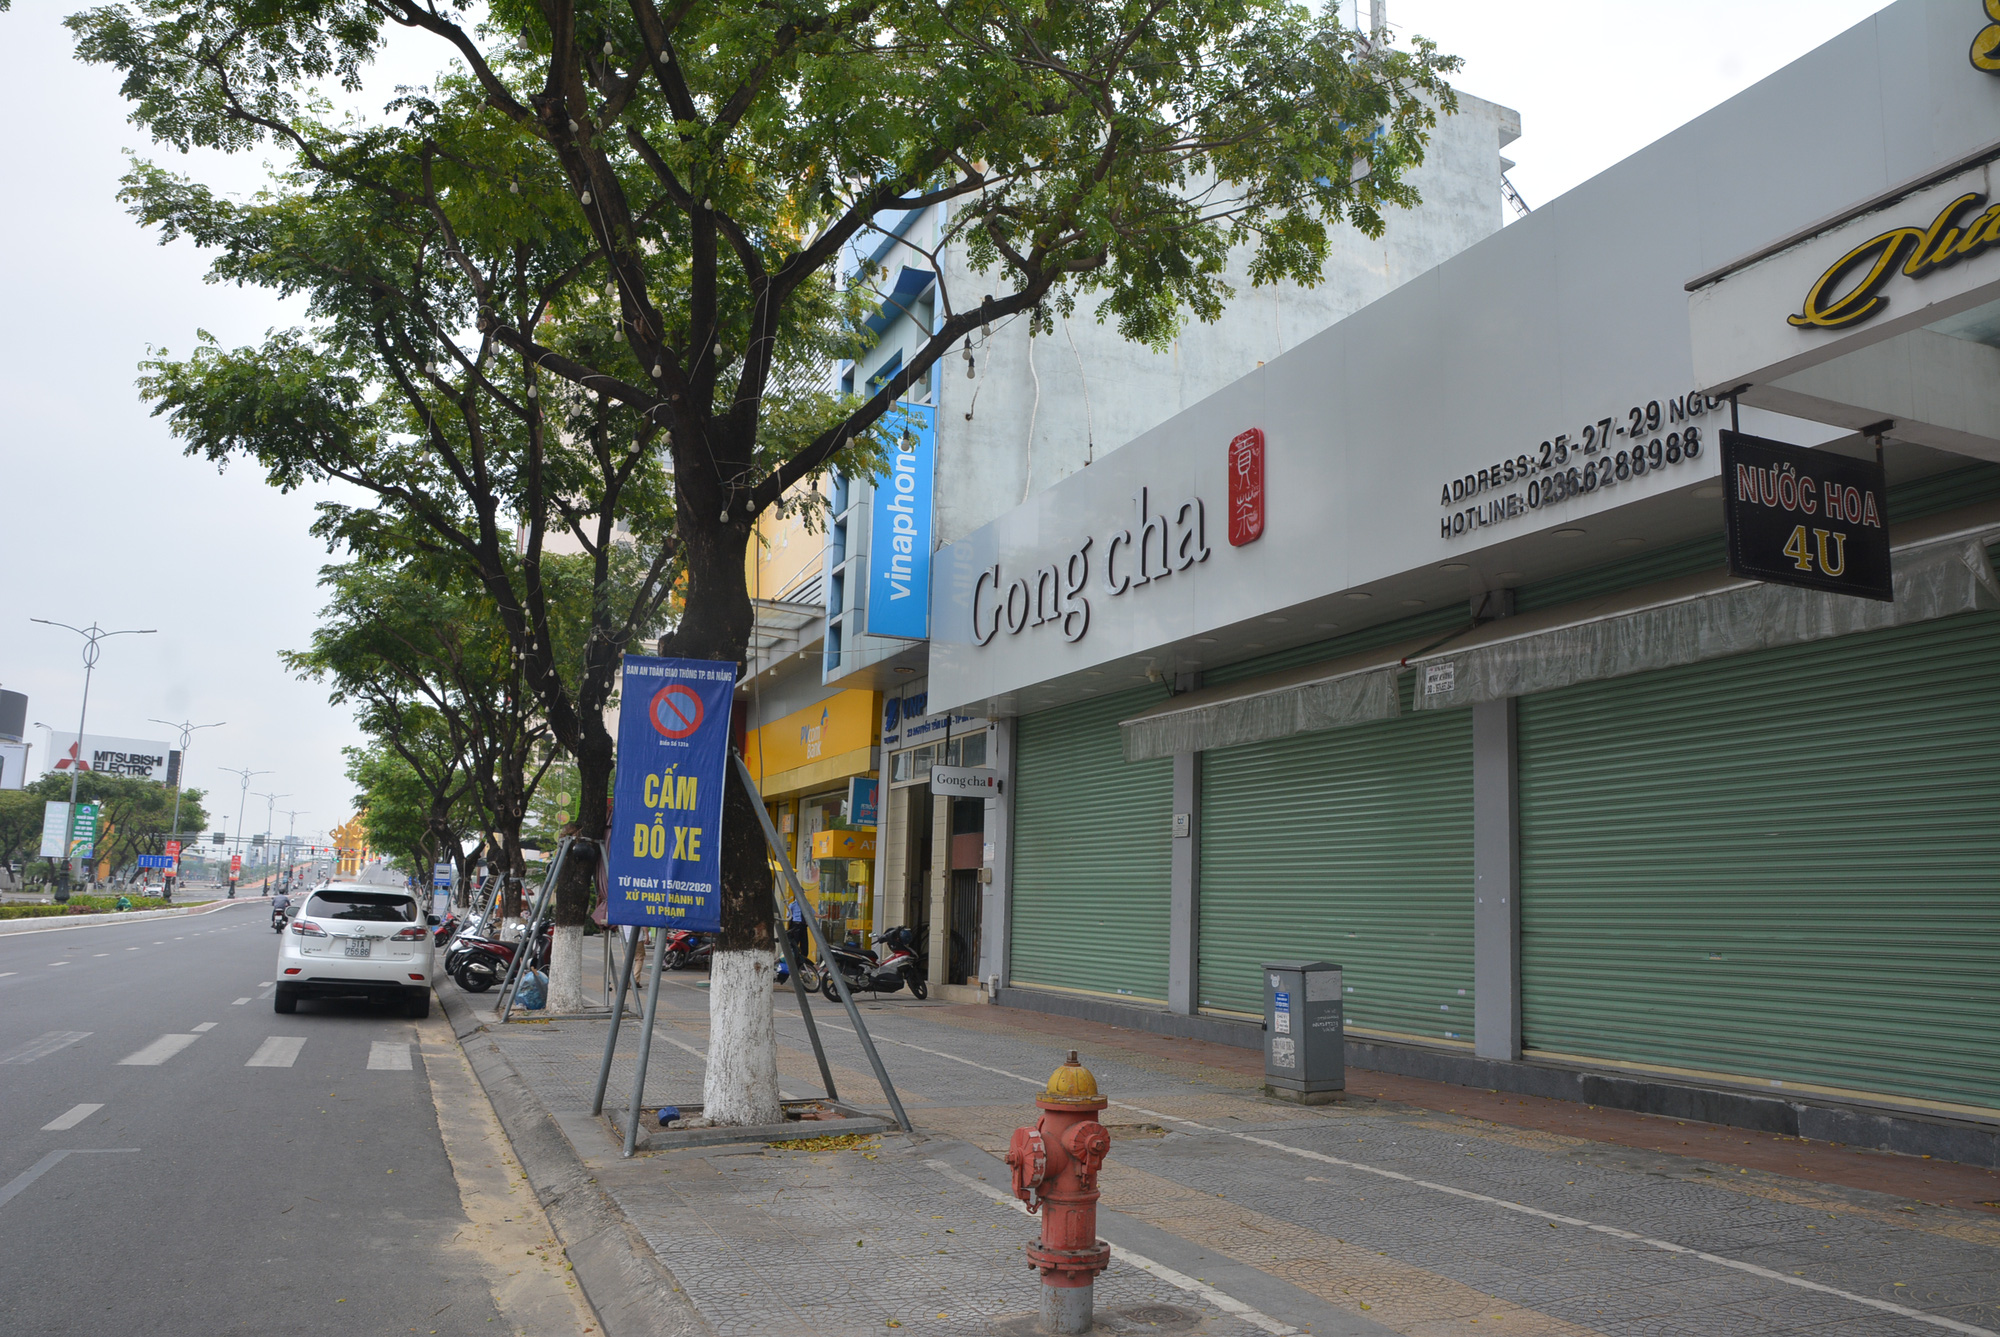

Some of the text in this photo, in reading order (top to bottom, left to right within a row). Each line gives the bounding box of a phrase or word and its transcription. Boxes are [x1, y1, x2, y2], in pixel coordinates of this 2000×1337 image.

[1736, 462, 1881, 529] NƯỚC HOA
[1782, 524, 1847, 577] 4U
[969, 486, 1212, 648] Gong cha
[626, 665, 639, 675] BAN
[640, 666, 649, 676] AN
[664, 667, 679, 678] GIAO
[902, 690, 928, 719] VNP
[94, 750, 163, 767] MITSUBISHI
[93, 761, 153, 776] ELECTRIC
[643, 763, 698, 811] CẤM
[936, 773, 986, 789] Gong cha
[633, 812, 703, 862] ĐỖ XE
[618, 875, 712, 893] TỪ NGÀY 15/02/2020
[625, 888, 704, 906] XỬ PHẠT HÀNH VI
[646, 905, 685, 918] VI PHẠM
[352, 939, 365, 948] 51A
